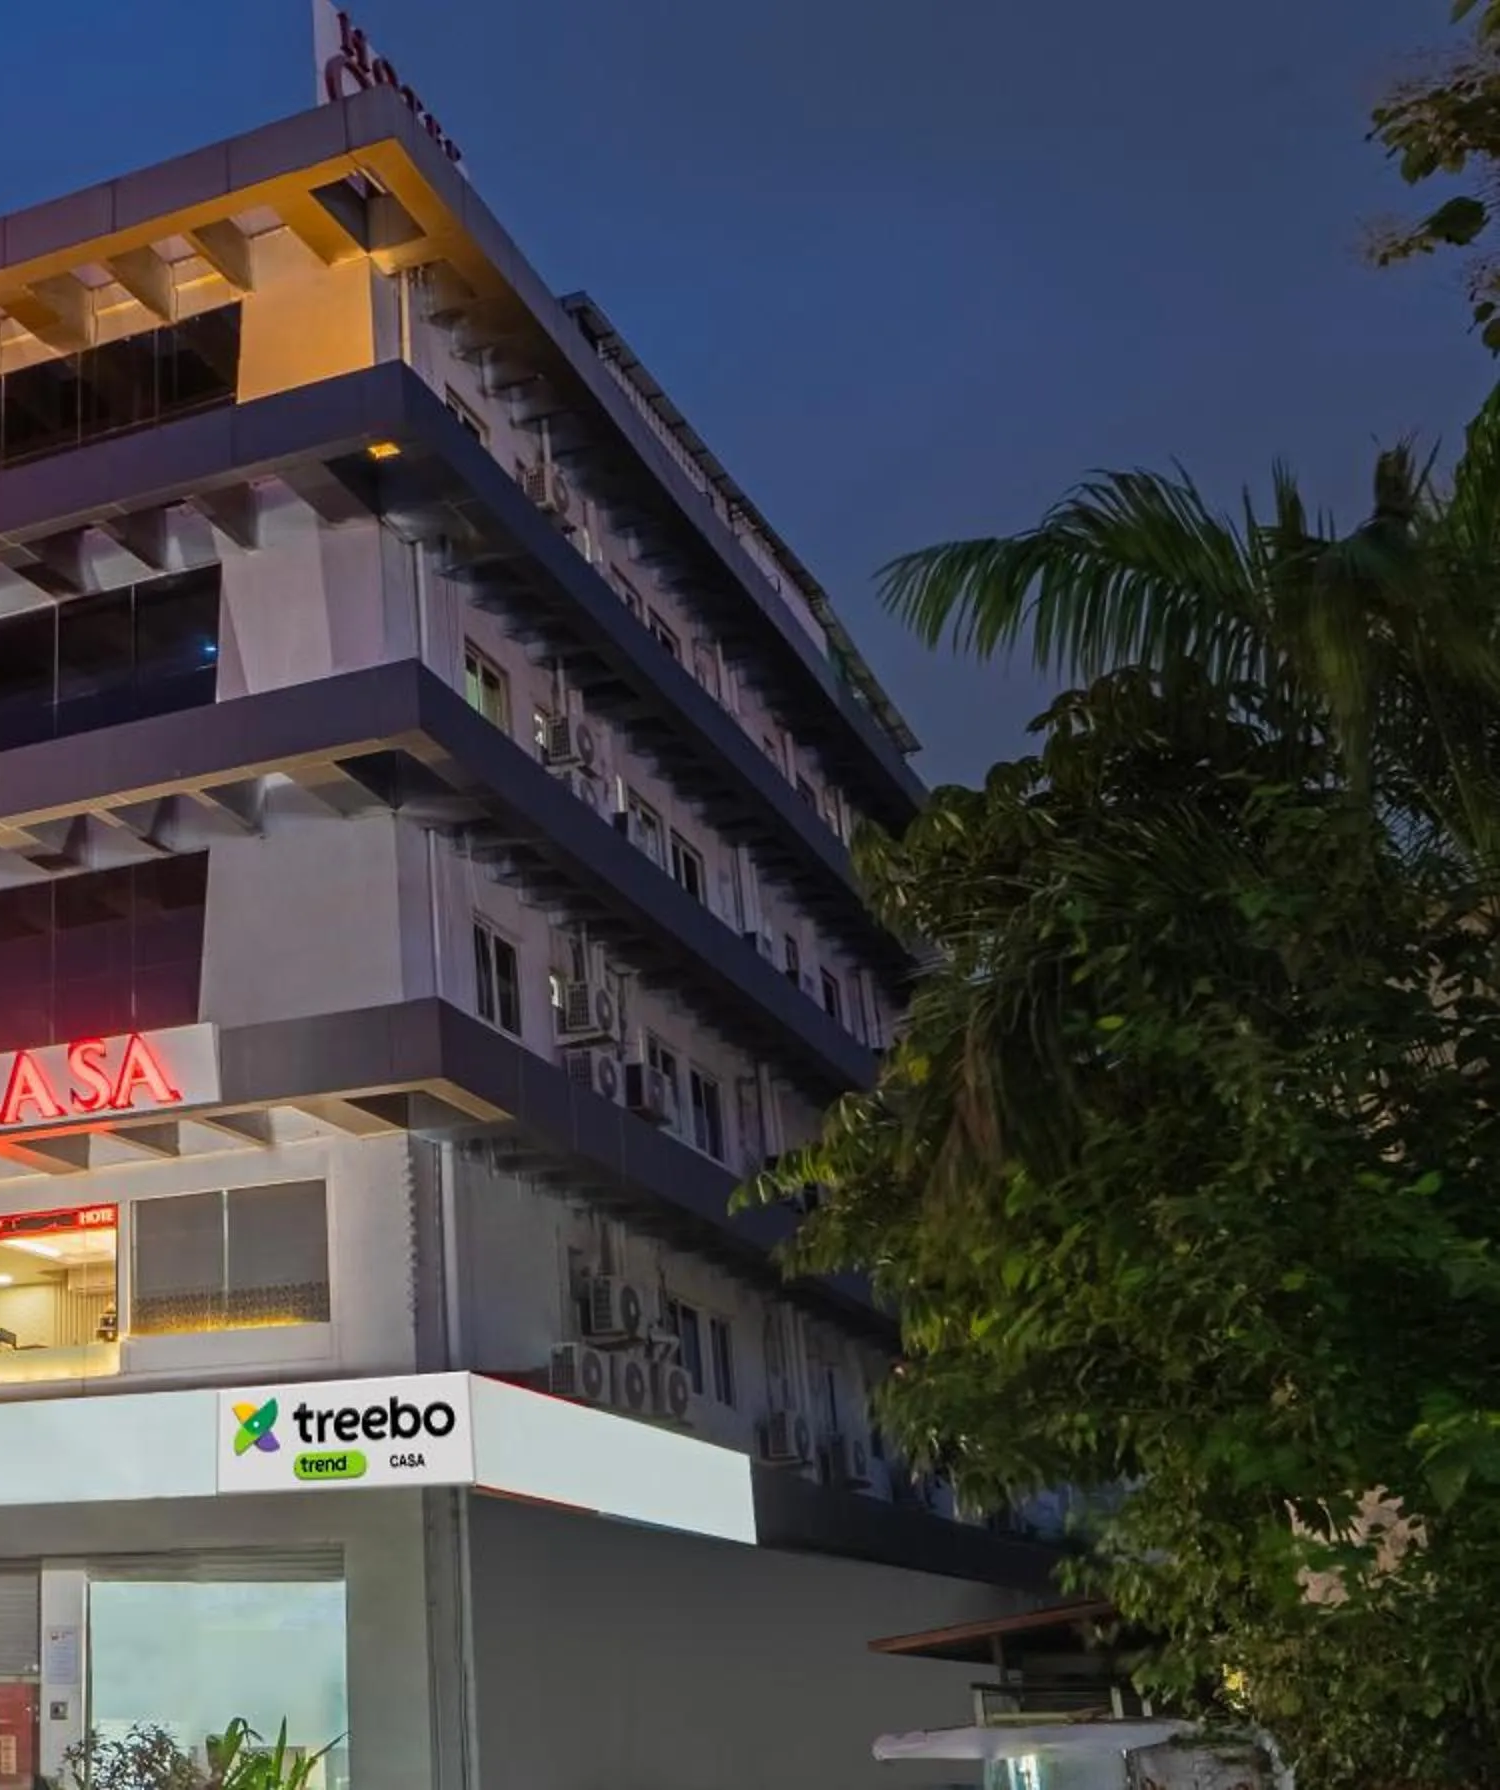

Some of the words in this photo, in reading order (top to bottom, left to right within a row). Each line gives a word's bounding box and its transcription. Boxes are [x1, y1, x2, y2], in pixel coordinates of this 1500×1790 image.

[293, 1396, 456, 1444] treebo
[300, 1454, 348, 1473] trend
[388, 1453, 426, 1469] CASA
